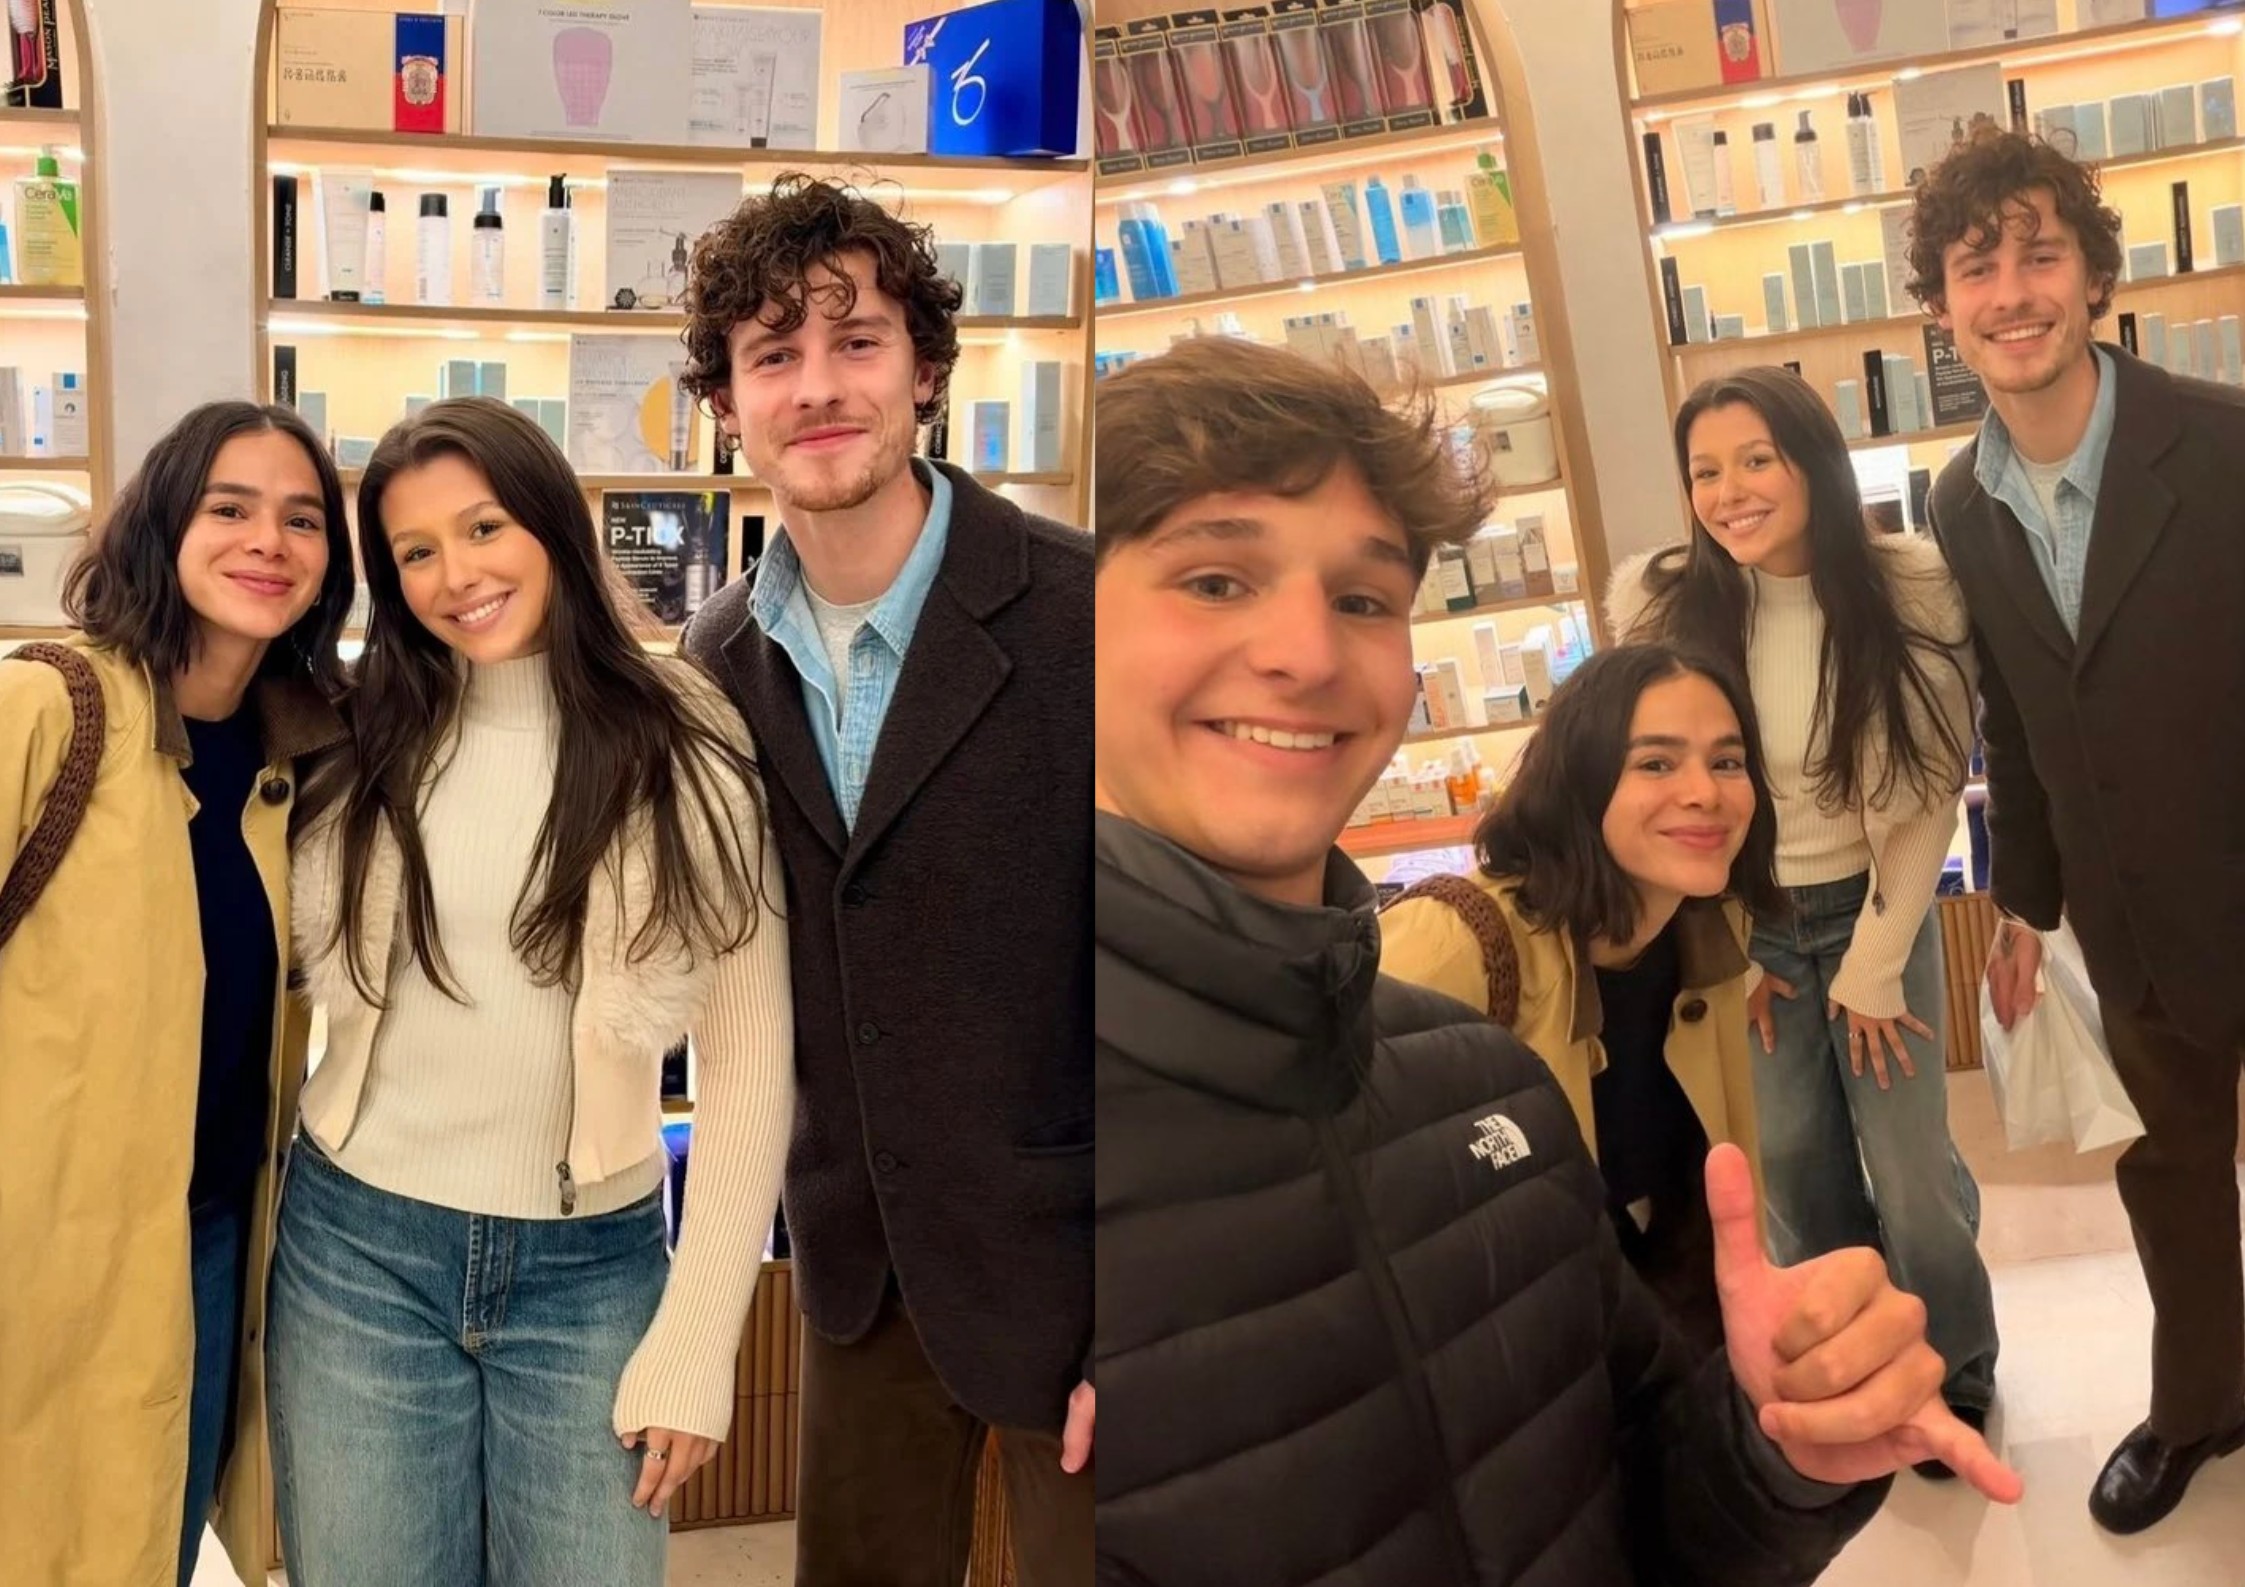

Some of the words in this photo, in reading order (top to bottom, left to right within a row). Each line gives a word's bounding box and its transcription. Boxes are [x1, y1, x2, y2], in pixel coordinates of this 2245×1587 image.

[610, 526, 685, 546] P-TIX
[1474, 1114, 1501, 1135] THE
[1468, 1130, 1513, 1160] NORTH
[1490, 1147, 1519, 1171] FACE
